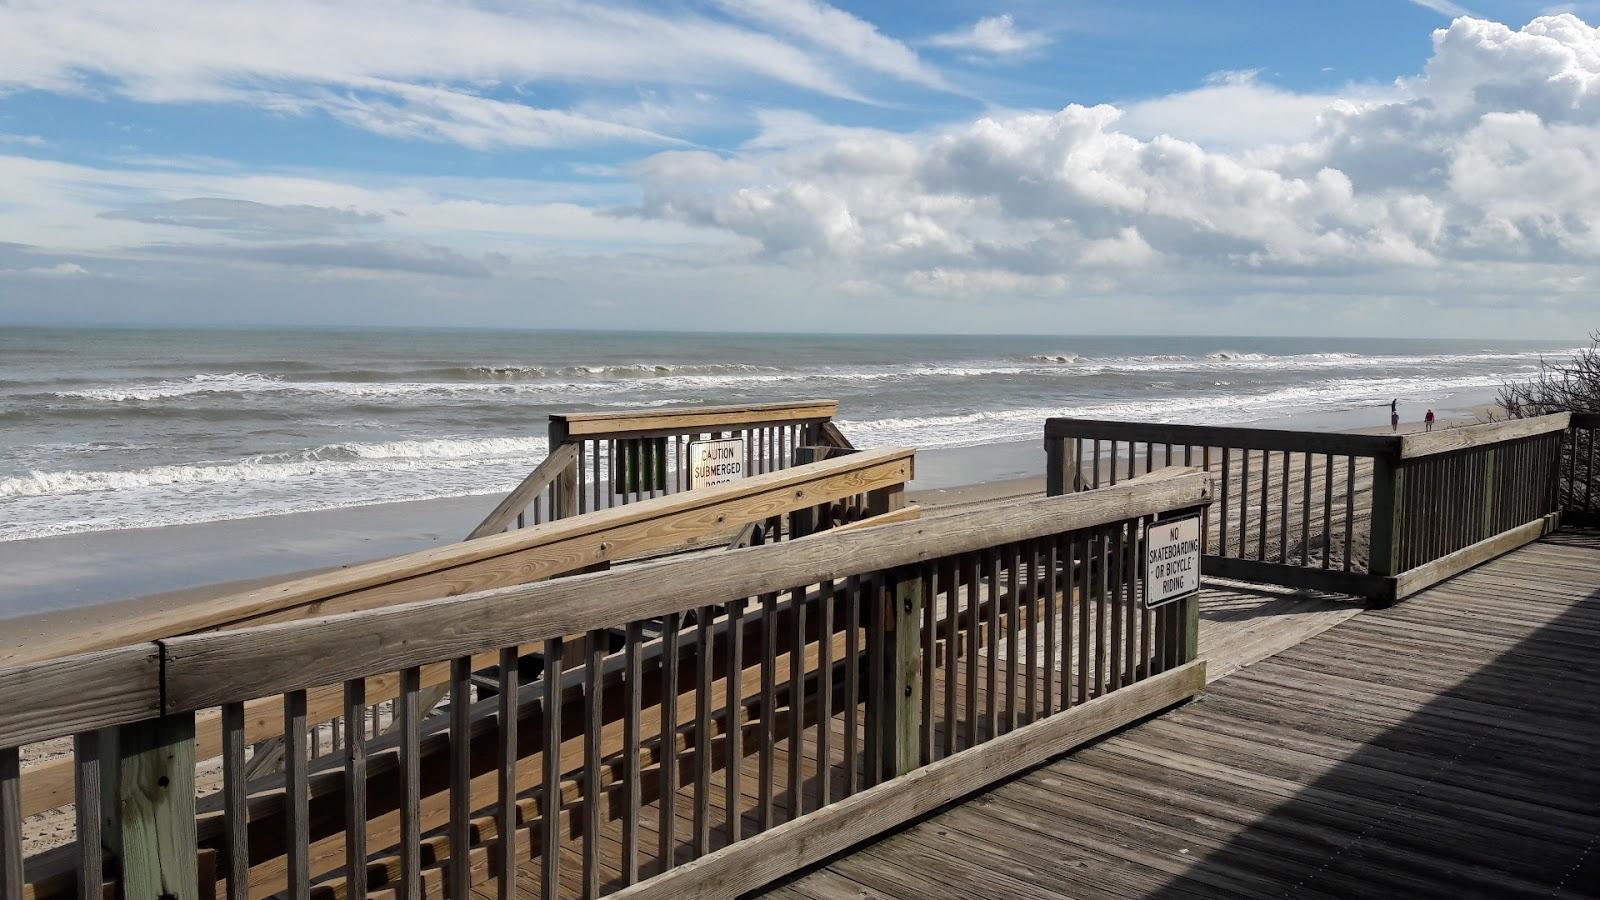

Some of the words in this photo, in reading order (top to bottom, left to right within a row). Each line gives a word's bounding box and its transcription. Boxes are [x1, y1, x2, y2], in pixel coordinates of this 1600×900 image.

[702, 447, 734, 461] CAUTION
[694, 462, 741, 479] SUBMERGED
[1169, 527, 1179, 541] NO
[1149, 539, 1198, 564] SKATEBOARDING
[1155, 565, 1164, 579] OR
[1166, 556, 1192, 576] BICYCLE
[1162, 576, 1184, 594] RIDING
